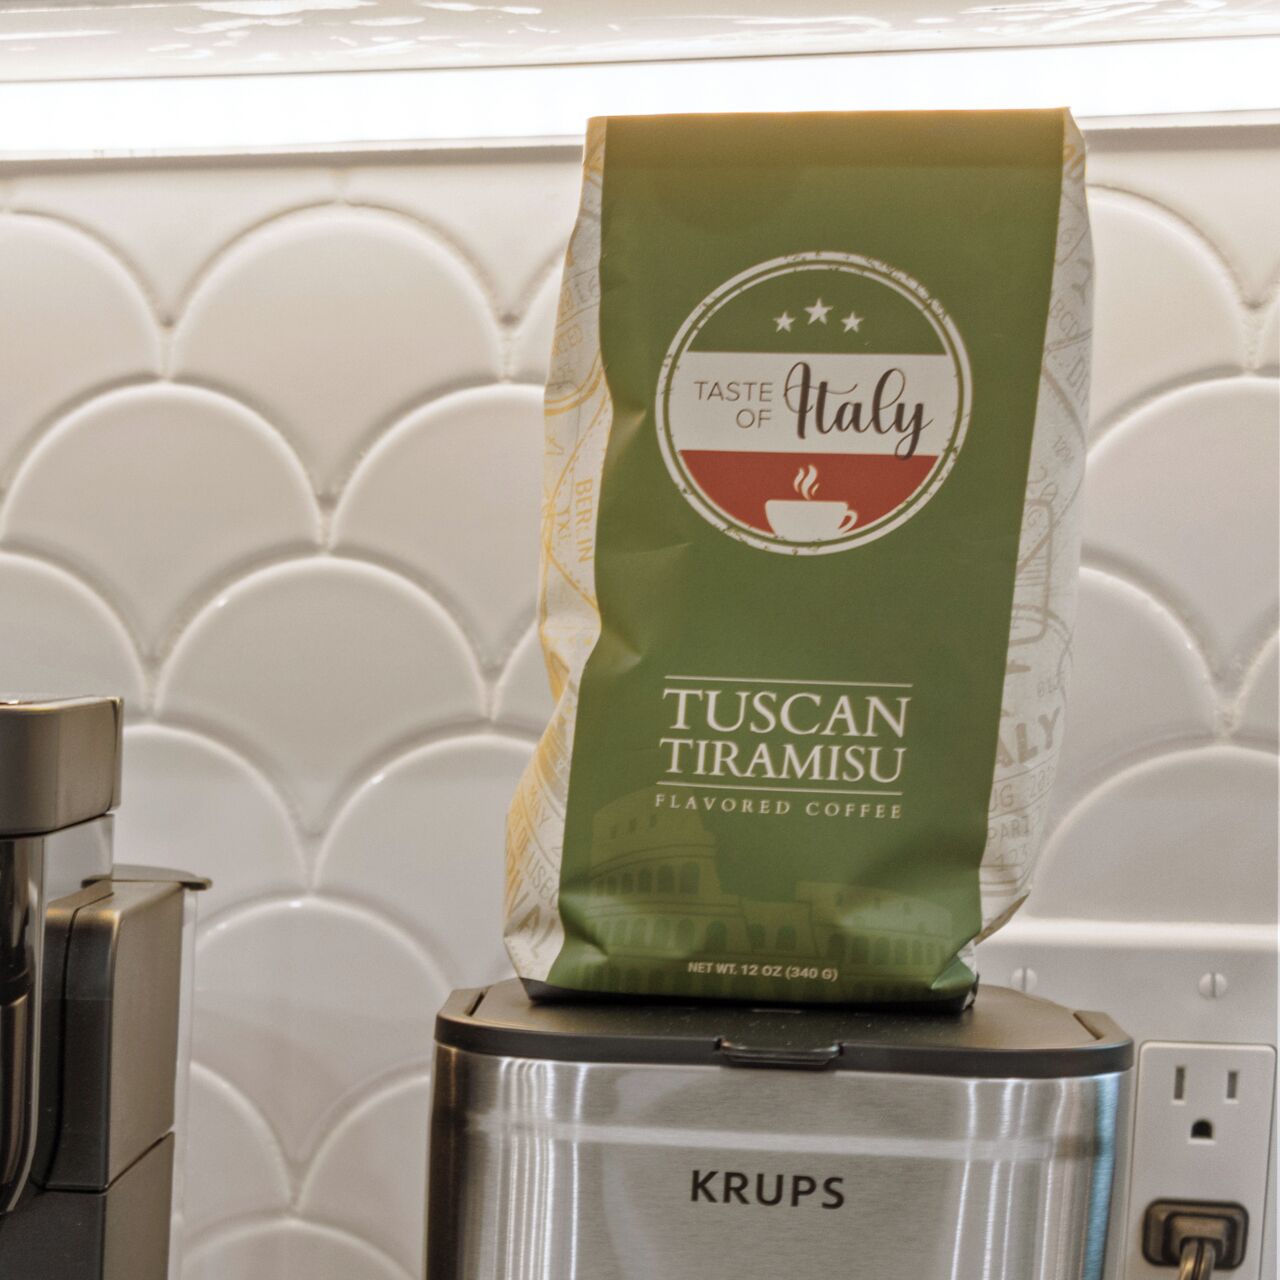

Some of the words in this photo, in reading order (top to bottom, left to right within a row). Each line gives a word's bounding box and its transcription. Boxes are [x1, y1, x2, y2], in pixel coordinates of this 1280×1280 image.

[693, 381, 773, 403] TASTE
[736, 408, 772, 429] OF
[784, 361, 934, 461] Italy
[662, 688, 911, 738] TUSCAN
[659, 738, 907, 783] TIRAMISU
[655, 794, 790, 815] FLAVORED
[806, 802, 902, 818] COFFEE
[688, 961, 713, 974] NET
[715, 962, 738, 976] WT.
[740, 963, 759, 976] 12
[762, 964, 782, 977] OZ
[785, 965, 817, 980] (340
[821, 967, 838, 982] G)
[691, 1169, 845, 1210] KRUPS
